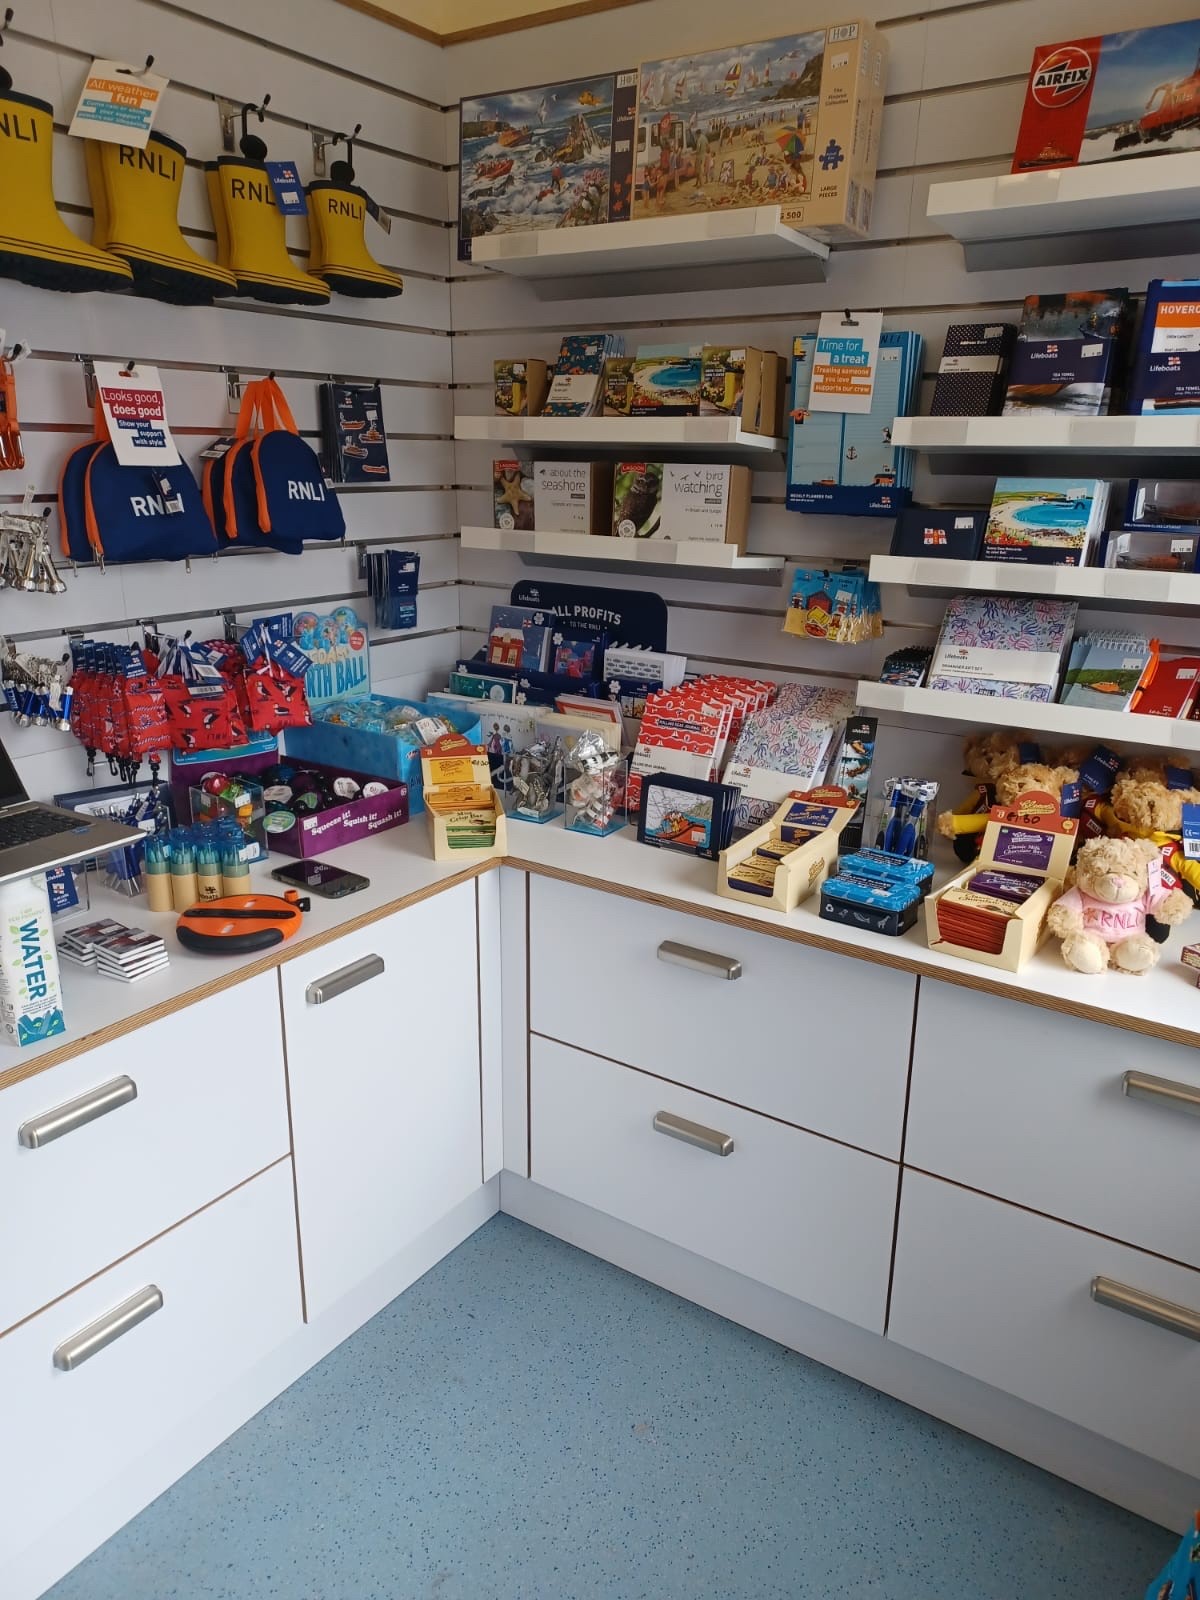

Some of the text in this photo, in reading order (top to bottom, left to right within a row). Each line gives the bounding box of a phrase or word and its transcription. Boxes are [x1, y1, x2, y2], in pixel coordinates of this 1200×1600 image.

[1035, 69, 1089, 87] AIRFIX
[89, 79, 156, 99] All weather
[115, 93, 138, 105] fun
[119, 145, 177, 182] RNLI
[231, 178, 277, 207] RNL
[328, 198, 363, 220] RNLI
[786, 211, 801, 219] 500
[821, 339, 860, 351] Time for
[833, 354, 865, 365] a treat
[103, 389, 160, 405] Looks good,
[113, 403, 162, 418] does good
[550, 469, 586, 478] about the
[705, 471, 724, 481] bird
[287, 480, 326, 502] RNLI
[541, 479, 586, 492] seashore
[674, 480, 723, 497] watching
[130, 493, 185, 517] RNI
[553, 605, 622, 625] ALL PROFITS
[335, 656, 367, 694] BALL
[311, 815, 342, 836] Squeeze
[343, 812, 378, 827] Squish it!
[367, 815, 393, 830] Squash
[1100, 910, 1140, 929] RNLI
[19, 918, 47, 1001] WATER
